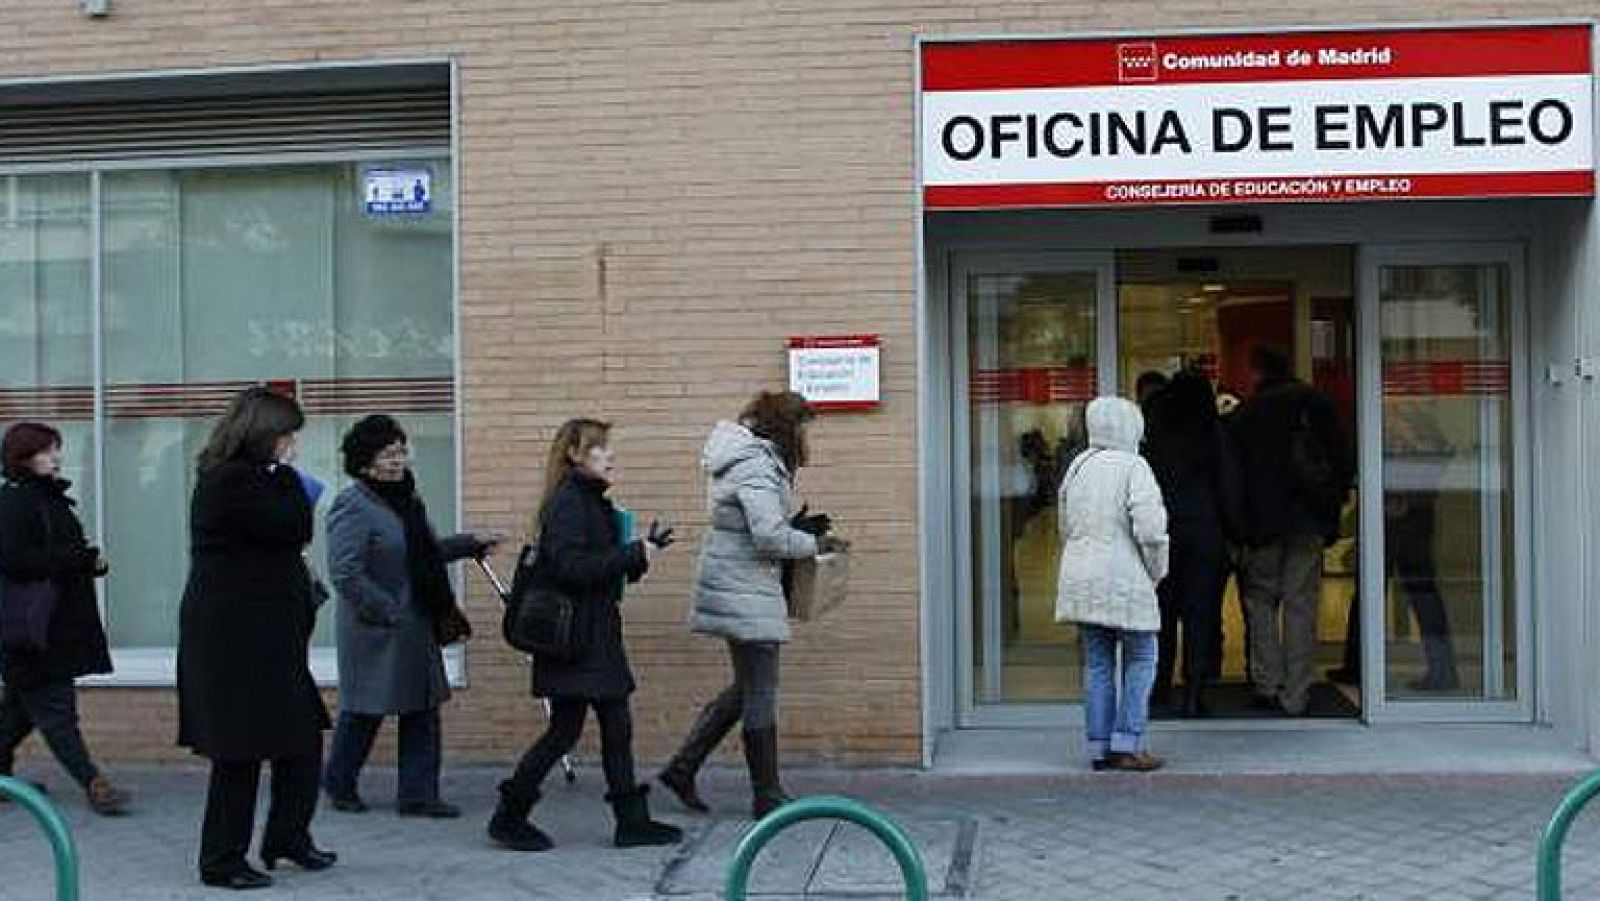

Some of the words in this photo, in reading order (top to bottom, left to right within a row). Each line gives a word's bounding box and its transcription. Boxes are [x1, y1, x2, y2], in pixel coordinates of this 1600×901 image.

[1162, 50, 1280, 70] Comunidad
[1286, 49, 1312, 66] de
[1318, 47, 1391, 66] Madrid
[941, 110, 1192, 161] OFICINA
[1212, 106, 1294, 153] DE
[1315, 98, 1574, 150] EMPLEO
[1209, 181, 1230, 197] DE
[1235, 178, 1327, 196] EDUCACIÓN
[1330, 179, 1341, 194] Y
[1345, 178, 1412, 193] EMPLEO
